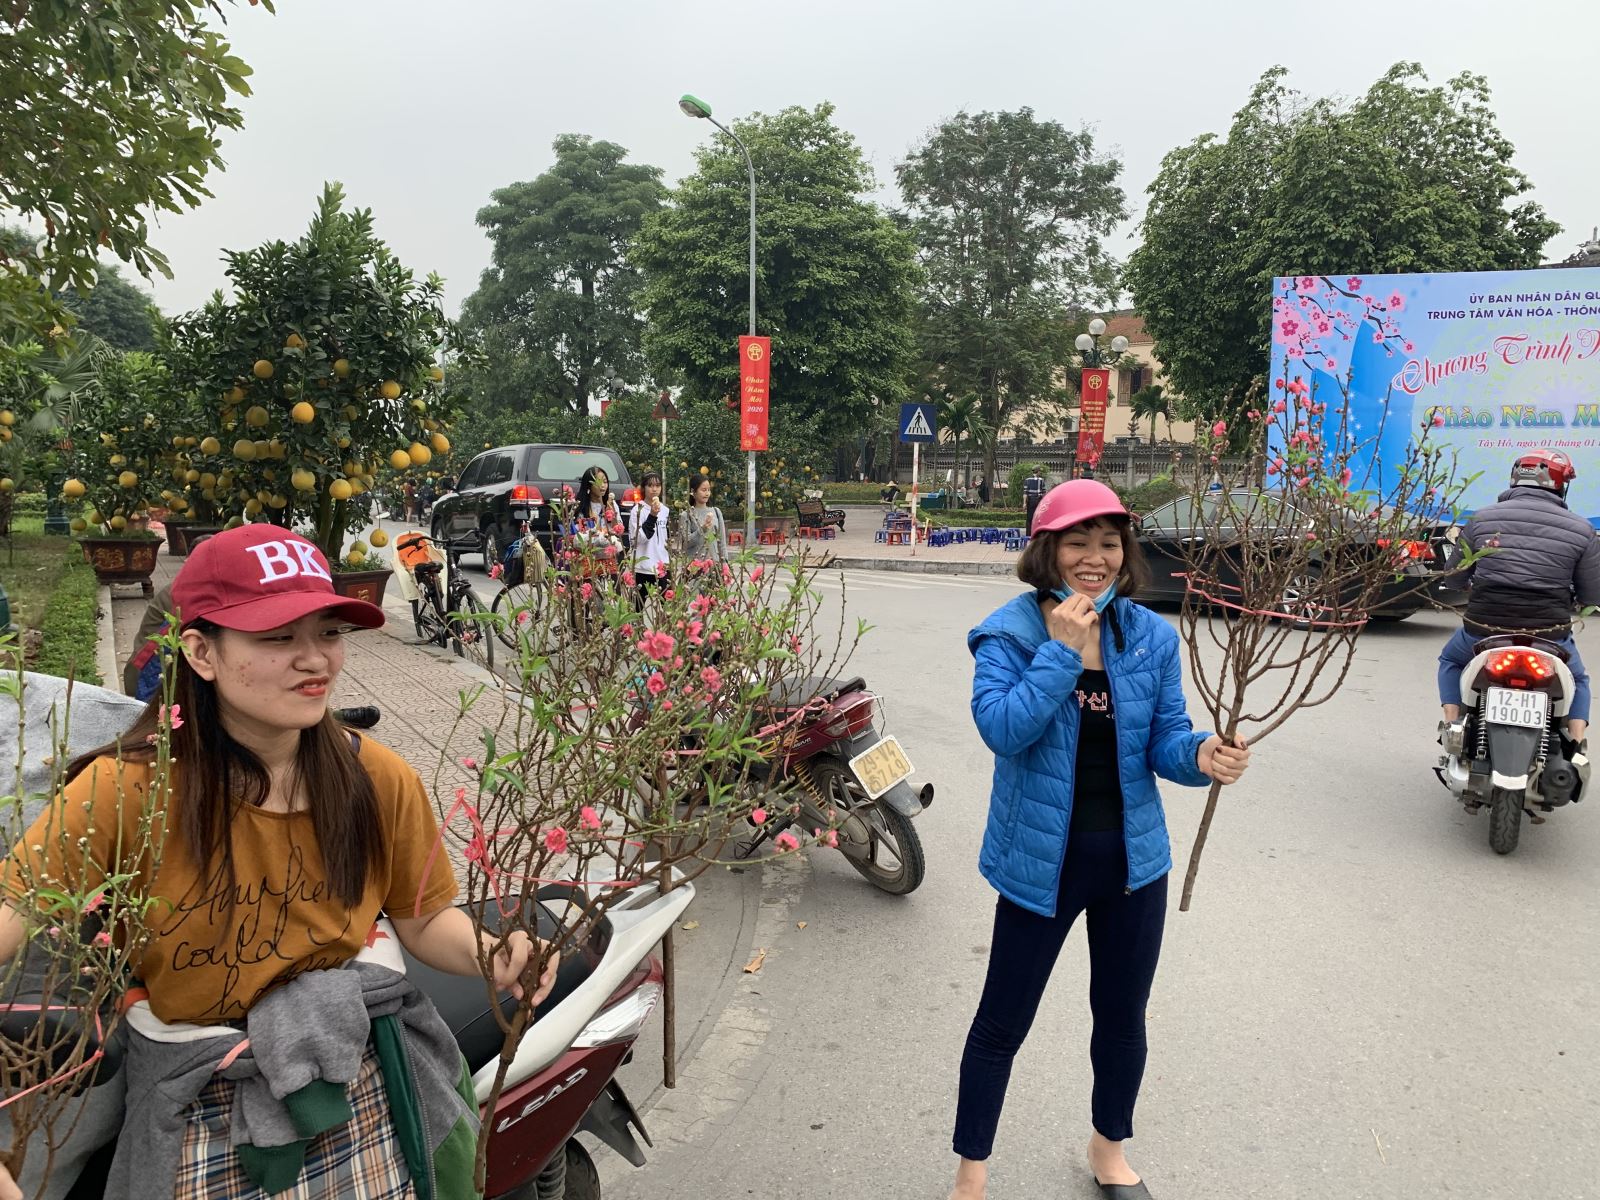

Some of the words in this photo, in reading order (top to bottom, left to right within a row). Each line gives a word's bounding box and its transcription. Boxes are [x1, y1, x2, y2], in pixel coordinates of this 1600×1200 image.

[1470, 293, 1484, 304] ỦY
[1488, 294, 1512, 304] BAN
[1516, 291, 1551, 303] NHÂN
[1554, 290, 1581, 301] DÂN
[1427, 310, 1466, 320] TRUNG
[1470, 308, 1494, 319] TÂM
[1497, 307, 1523, 318] VĂN
[1526, 306, 1554, 317] HÓA
[1564, 305, 1600, 316] THÔN
[1501, 404, 1565, 427] Năm
[245, 539, 333, 584] BK
[1498, 691, 1537, 709] 12-H1
[1491, 706, 1542, 725] 190.03
[173, 902, 293, 971] could
[496, 1067, 589, 1133] LEAD
